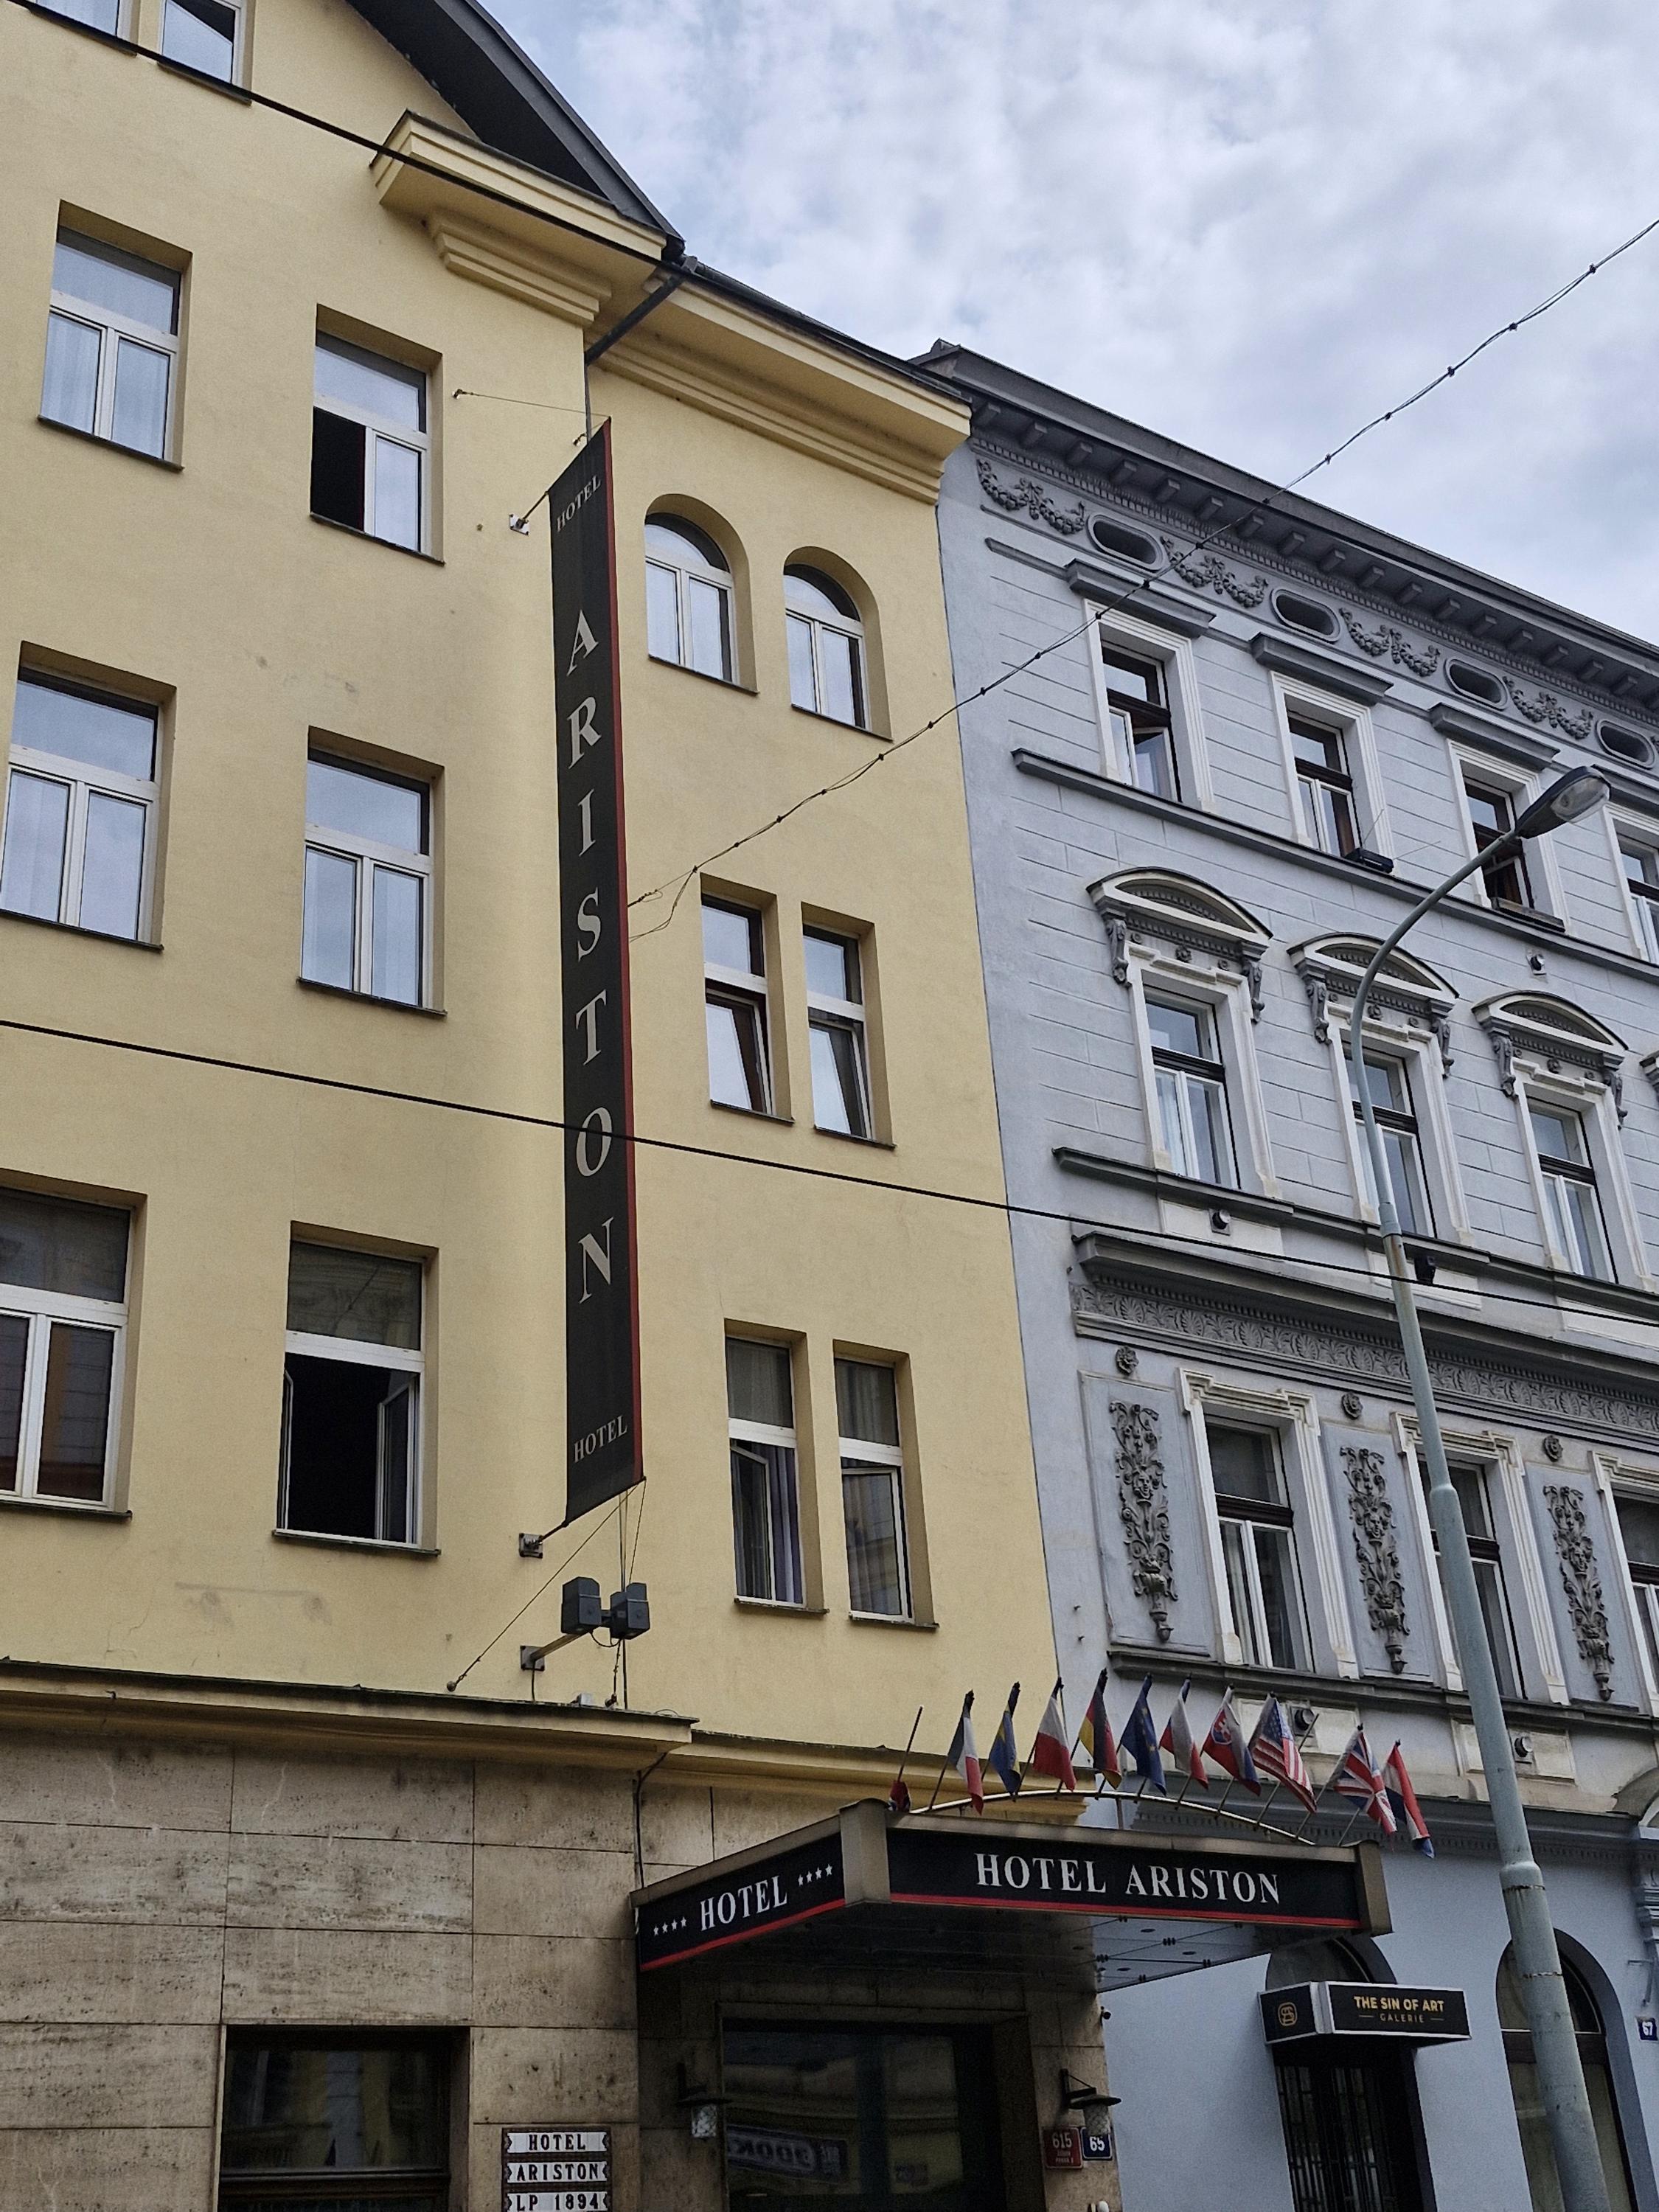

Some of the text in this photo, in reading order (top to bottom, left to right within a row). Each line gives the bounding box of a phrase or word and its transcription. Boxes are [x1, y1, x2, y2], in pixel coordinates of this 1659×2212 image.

[557, 476, 601, 532] HOTEL
[566, 609, 614, 1304] ARISTON
[574, 1415, 627, 1463] HOTEL
[974, 1853, 1280, 1905] HOTEL ARISTON
[701, 1876, 787, 1930] HOTEL
[1354, 1996, 1444, 2012] THE SIN OF ART
[1380, 2013, 1424, 2023] GALERIE
[529, 2134, 586, 2151] HOTEL
[1052, 2132, 1072, 2149] 615
[1089, 2136, 1105, 2152] 65
[517, 2163, 598, 2181] ARISTON
[517, 2193, 598, 2211] LP 1894
